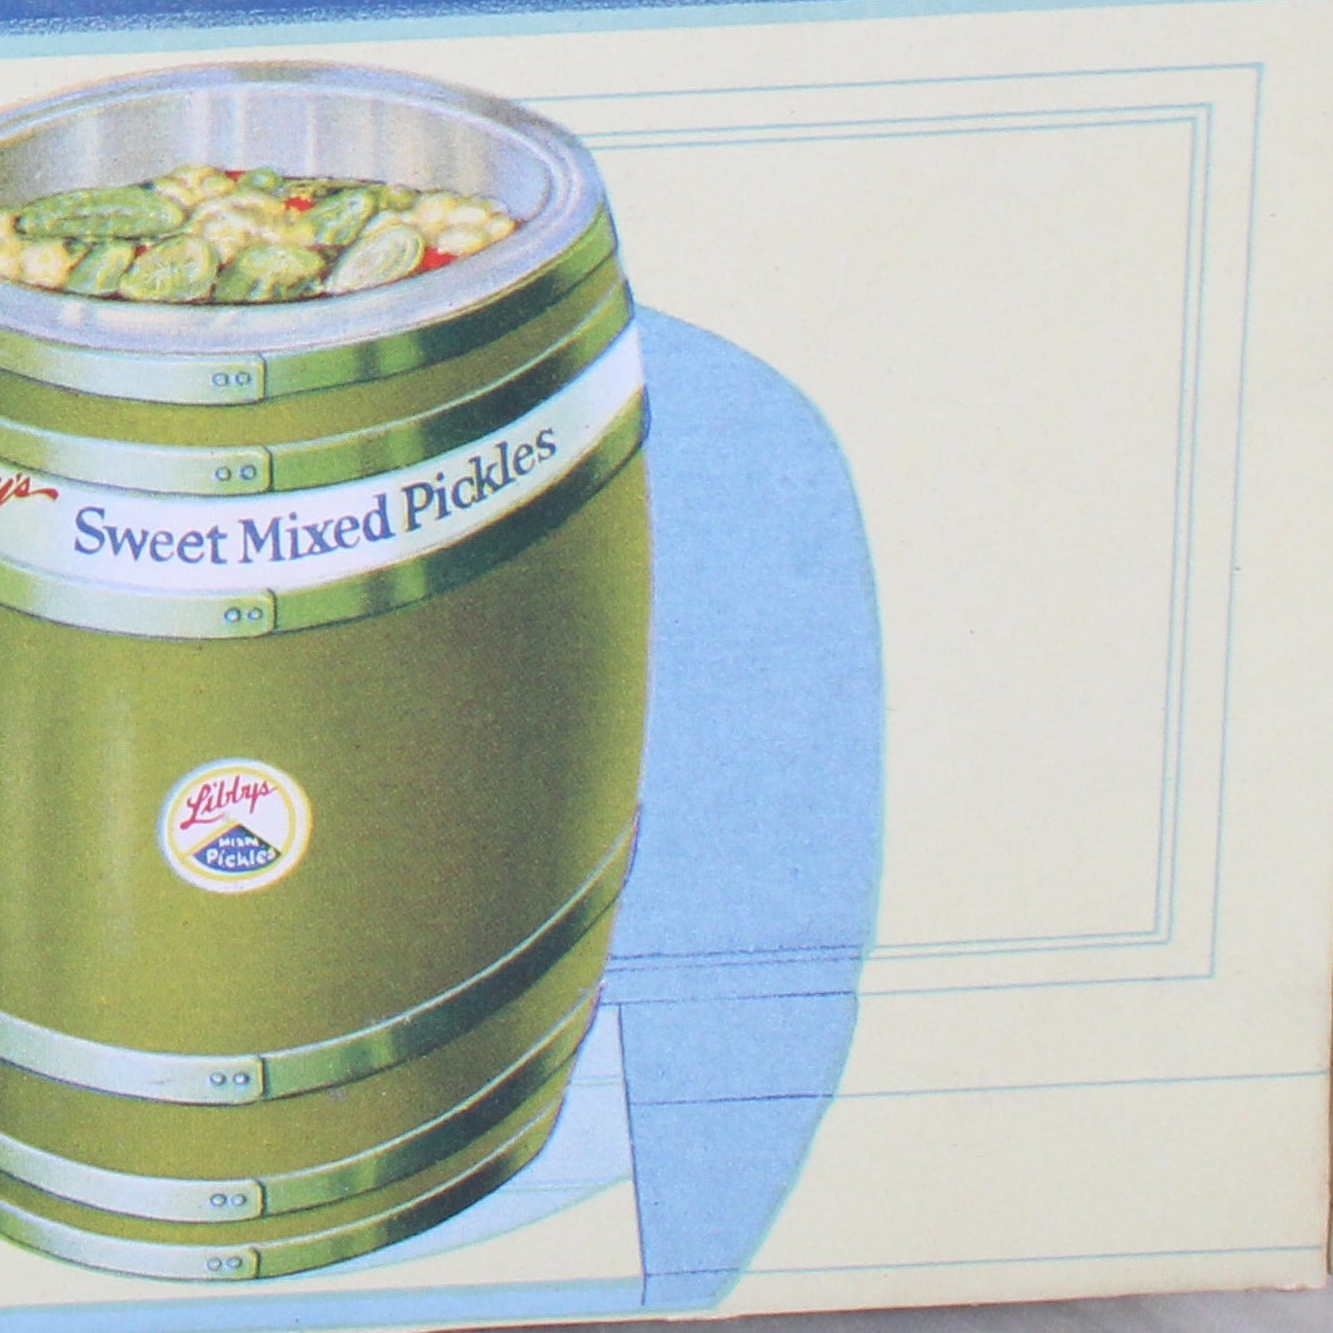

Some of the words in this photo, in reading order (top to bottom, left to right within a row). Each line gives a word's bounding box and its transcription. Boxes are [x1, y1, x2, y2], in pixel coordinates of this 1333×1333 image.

[73, 506, 229, 567] Sweet
[239, 494, 394, 566] Mixed
[404, 426, 559, 532] Pickles
[205, 847, 276, 869] Pickles
